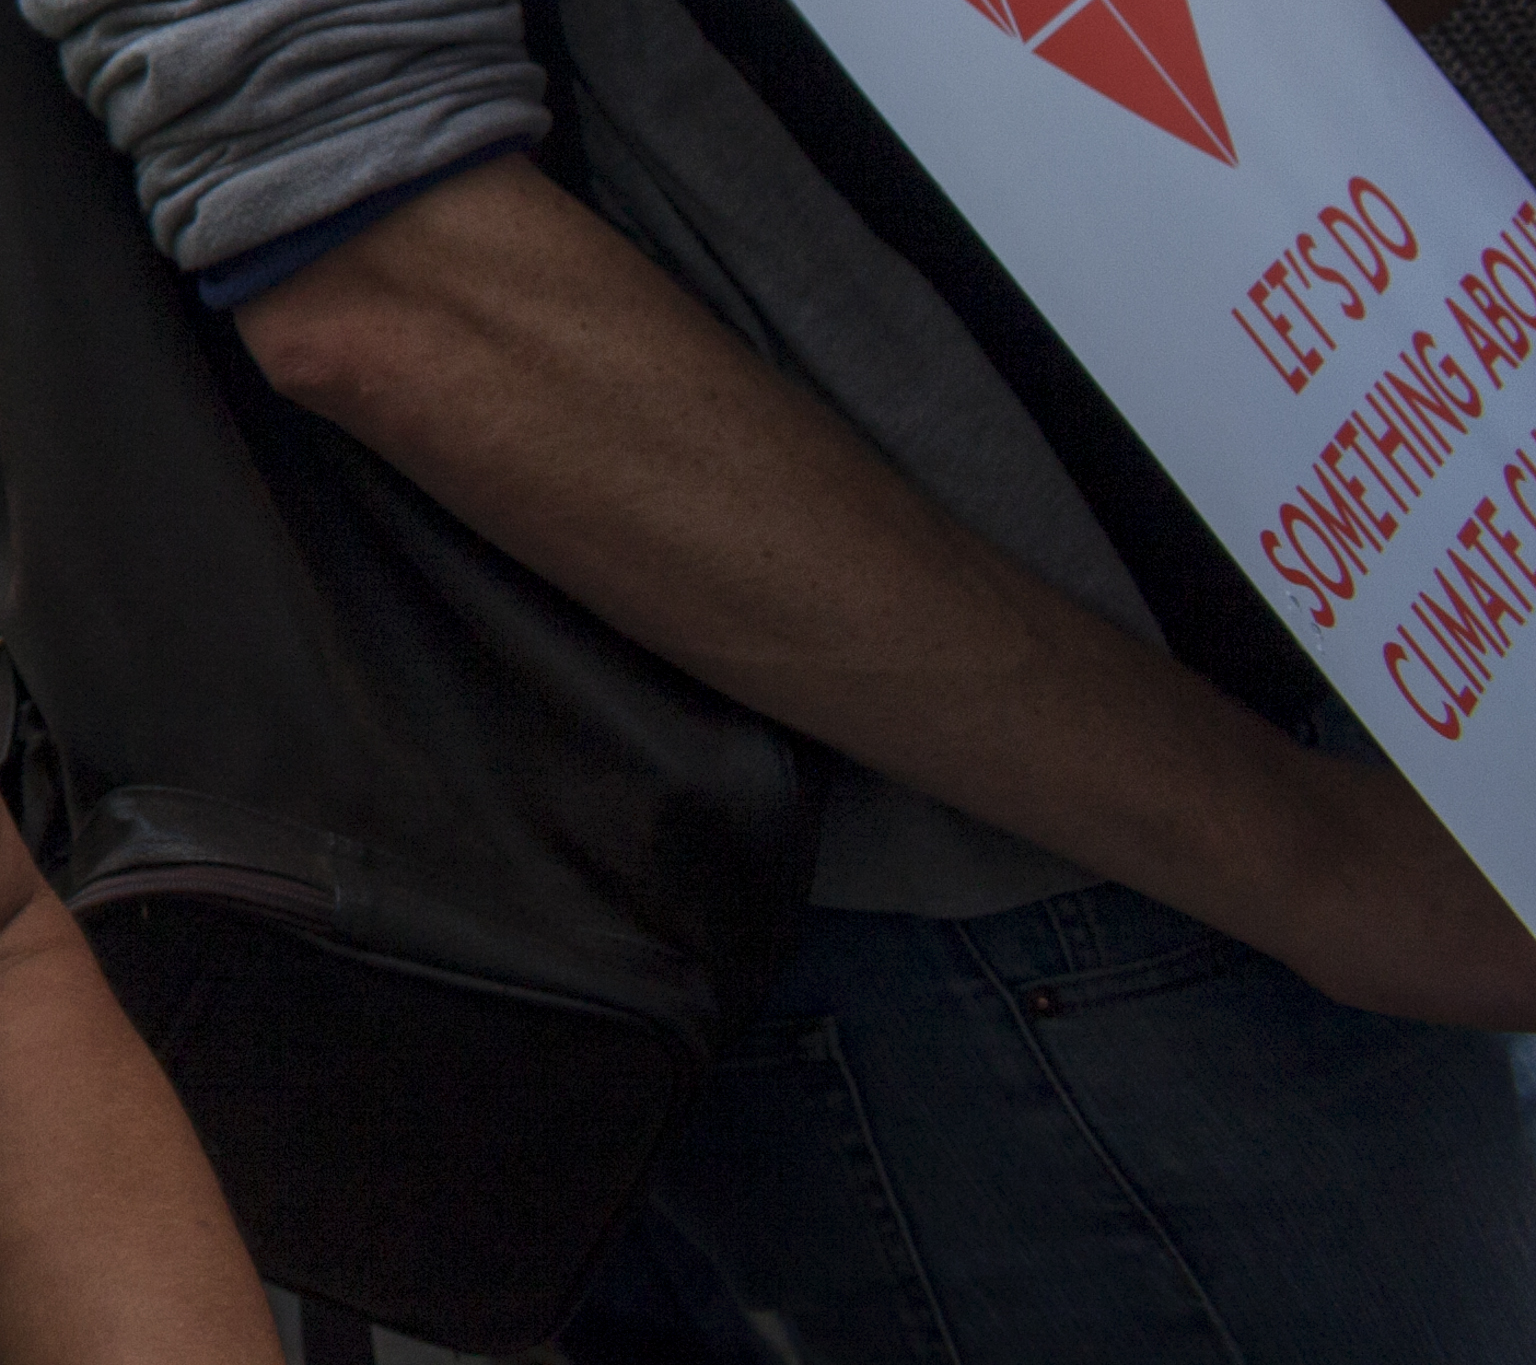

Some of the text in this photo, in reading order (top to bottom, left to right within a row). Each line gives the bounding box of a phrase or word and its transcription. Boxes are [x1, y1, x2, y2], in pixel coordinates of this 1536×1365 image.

[1231, 175, 1419, 397] LET'S DO
[1258, 329, 1484, 630] SOMETHING
[1382, 494, 1536, 743] CLIMATE
